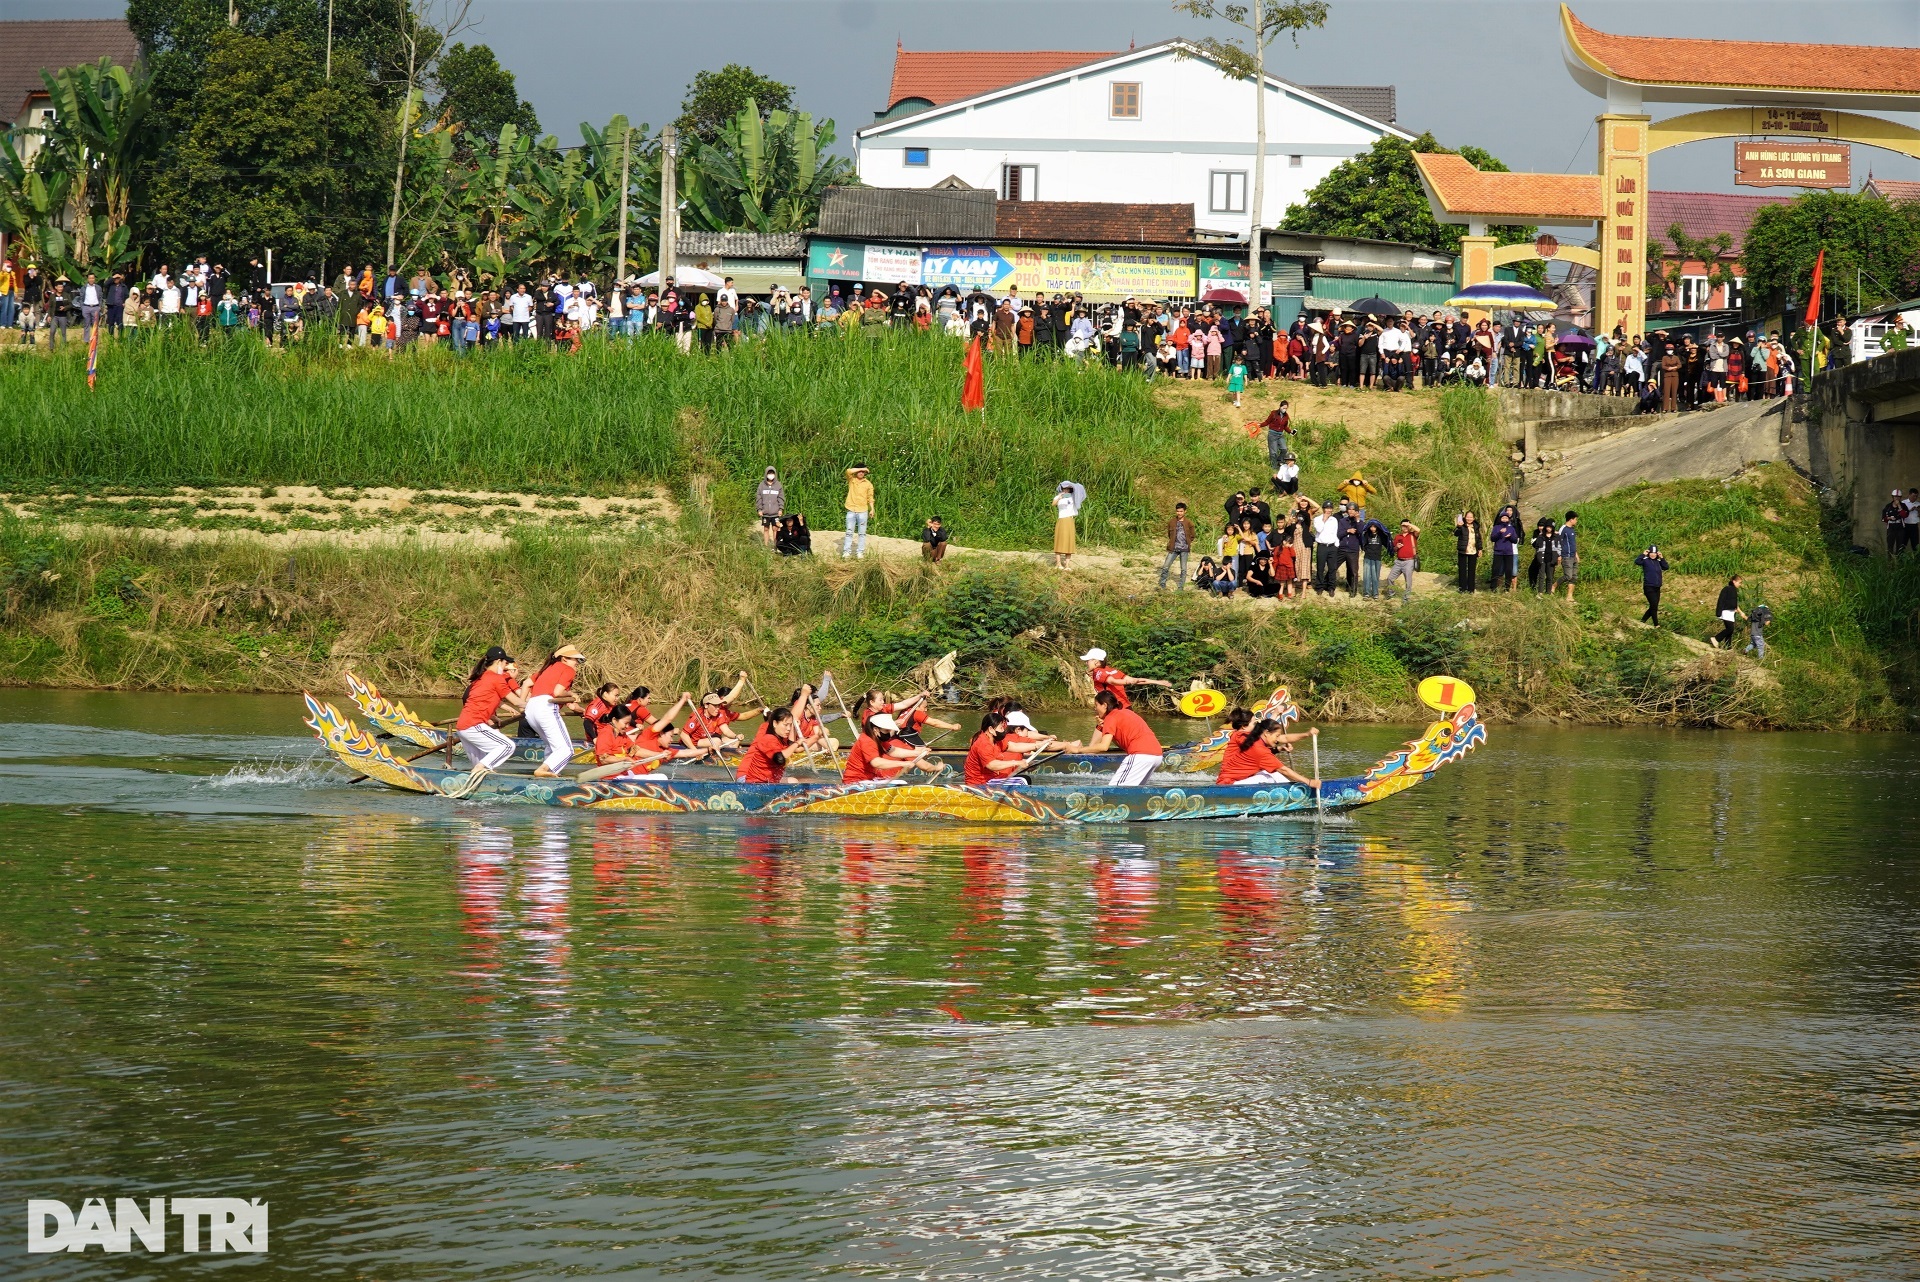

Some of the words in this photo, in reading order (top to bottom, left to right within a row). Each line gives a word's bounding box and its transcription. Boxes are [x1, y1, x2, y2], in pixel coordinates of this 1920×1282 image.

[1768, 110, 1778, 120] 14
[1786, 111, 1796, 120] 11
[1745, 151, 1759, 160] ANH
[1760, 150, 1777, 161] HÙNG
[1778, 152, 1790, 162] LỰC
[1791, 151, 1811, 163] LƯỢNG
[1812, 151, 1821, 162] VŨ
[1821, 153, 1842, 163] TRANG
[1760, 167, 1774, 178] XÃ
[1776, 168, 1795, 179] SƠN
[1797, 169, 1826, 179] GIANG
[1616, 174, 1636, 193] LÀNG
[1616, 198, 1635, 217] QUÁT
[1015, 249, 1043, 266] BÚN
[1123, 255, 1137, 263] RANG
[1166, 256, 1180, 266] RANG
[1617, 248, 1633, 263] HOA
[950, 259, 999, 275] NAN
[1048, 264, 1060, 276] BÒ
[1063, 265, 1080, 277] TÁI
[1015, 268, 1041, 287] PHỞ
[1162, 279, 1179, 288] TRỌN
[1616, 295, 1632, 313] VẠN
[1434, 683, 1457, 707] 1
[1192, 694, 1215, 714] 2
